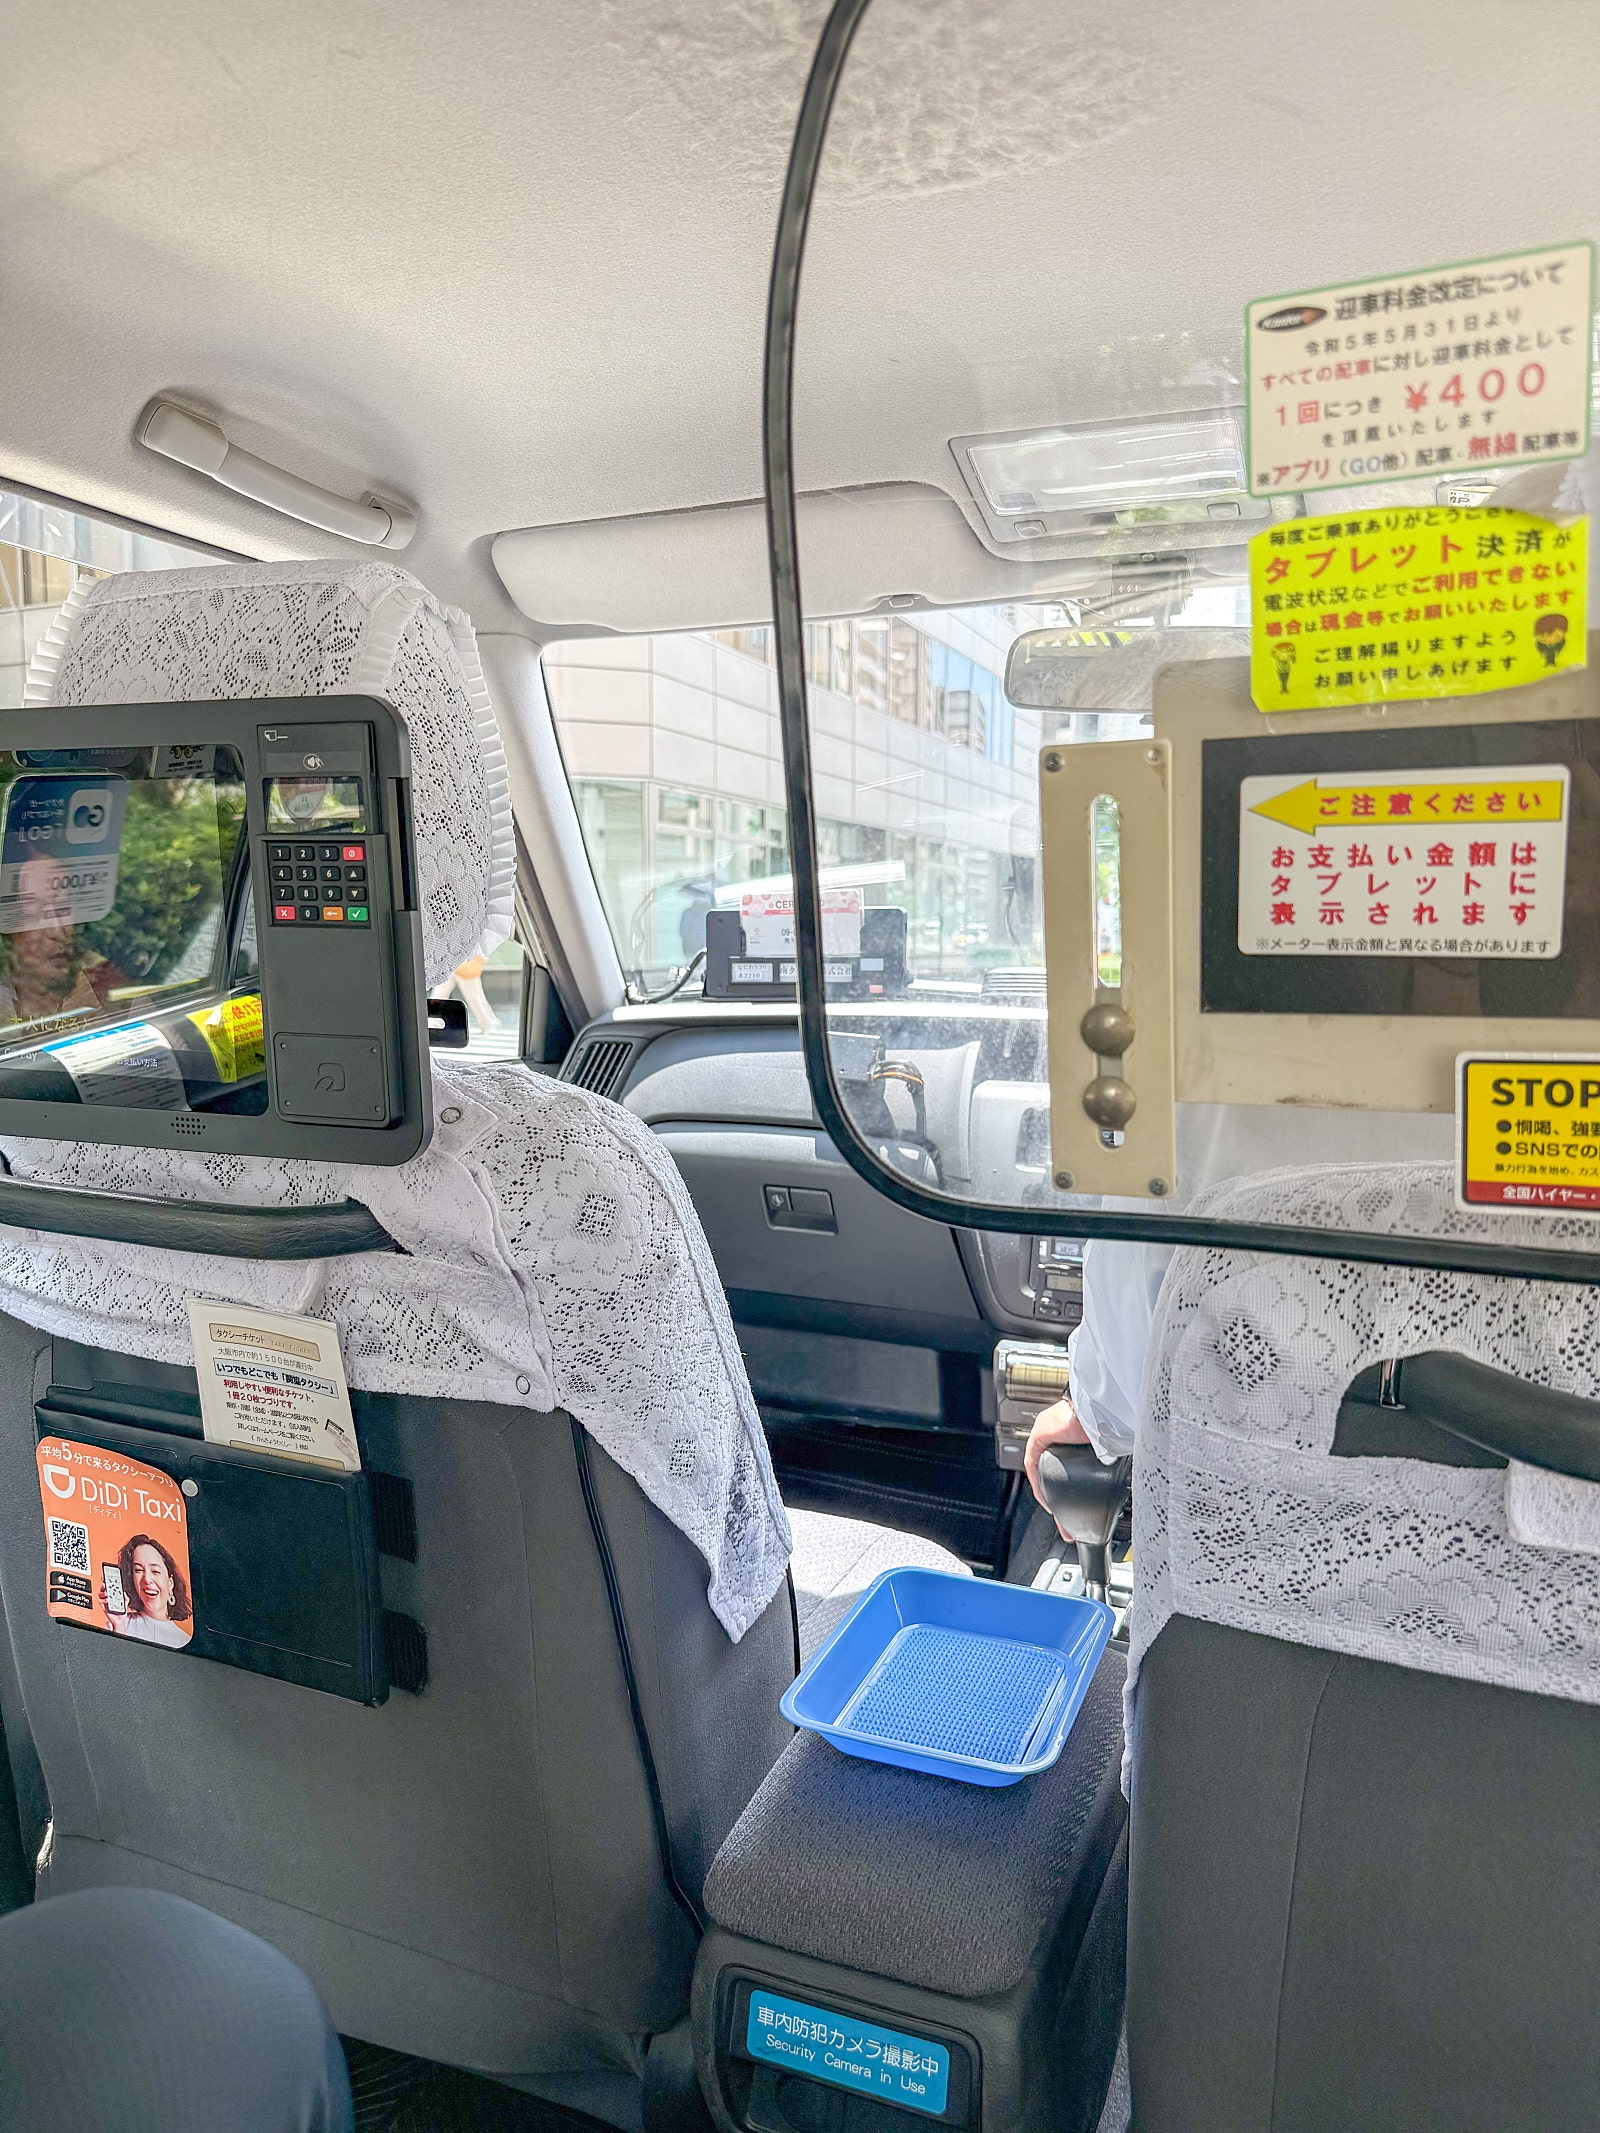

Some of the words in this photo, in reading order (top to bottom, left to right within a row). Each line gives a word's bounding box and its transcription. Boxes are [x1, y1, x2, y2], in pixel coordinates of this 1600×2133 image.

[1335, 260, 1566, 321] 迎車料金改定について
[1263, 560, 1576, 612] 電波状況などでご利用できない
[1314, 630, 1517, 665] ご理解賜りますよう
[1314, 656, 1518, 690] お願い申しあげます
[1318, 792, 1542, 817] ご注意ください
[277, 849, 282, 858] 1
[300, 849, 306, 858] 2
[325, 849, 330, 858] 3
[1270, 841, 1538, 869] お支払い金額は
[278, 869, 284, 878] 4
[302, 869, 307, 878] 5
[326, 869, 332, 878] 6
[1270, 871, 1537, 897] タブレットに
[280, 889, 285, 897] 7
[303, 889, 309, 897] 8
[328, 889, 333, 898] 9
[305, 909, 311, 918] 0
[1270, 901, 1536, 926] 表示されます
[1491, 1077, 1600, 1109] STOP
[81, 1476, 128, 1511] DiDi
[133, 1488, 182, 1523] Taxi
[757, 2006, 939, 2077] 車内防犯カメラ撮影中
[765, 2033, 816, 2062] Security
[824, 2052, 872, 2079] Camera
[880, 2068, 892, 2084] in
[900, 2077, 926, 2095] Use
